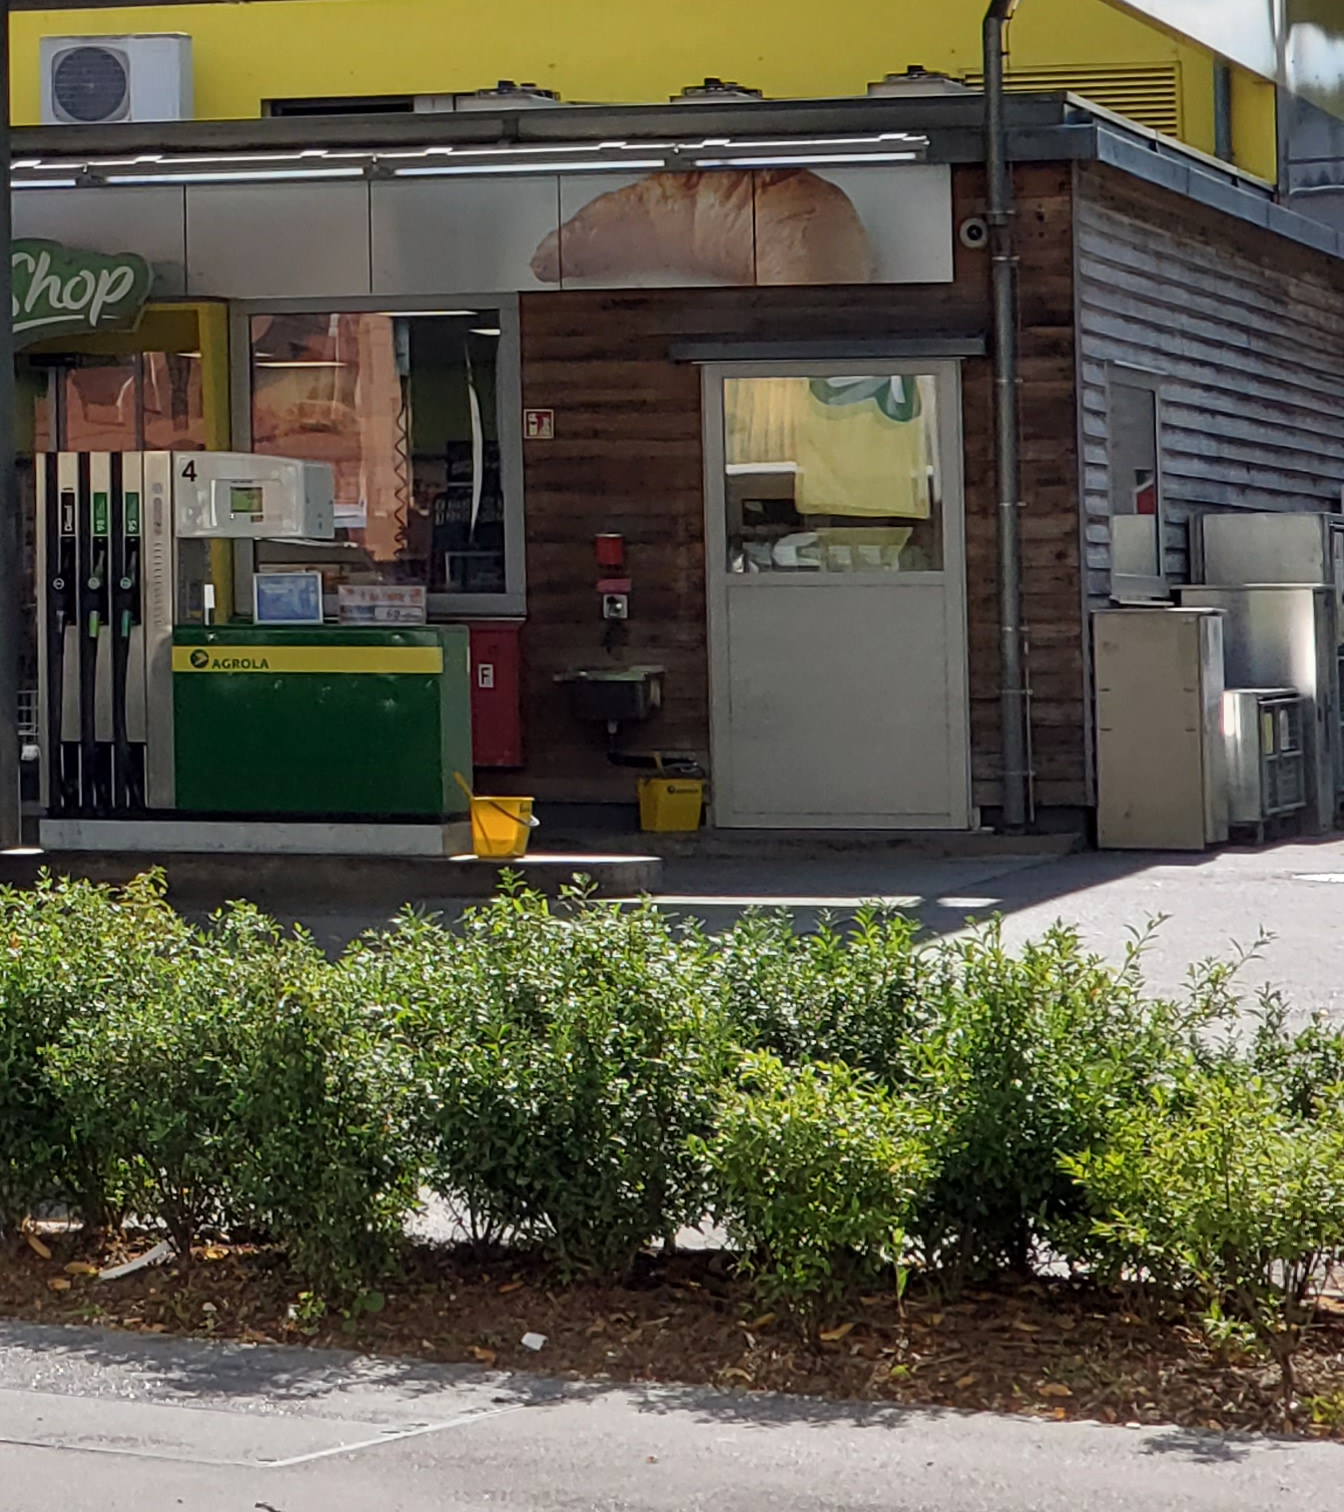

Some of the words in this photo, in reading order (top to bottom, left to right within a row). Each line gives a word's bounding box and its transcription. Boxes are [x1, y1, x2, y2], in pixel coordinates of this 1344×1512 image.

[182, 460, 197, 482] 4
[211, 658, 270, 669] AGROLA
[480, 667, 490, 685] F
